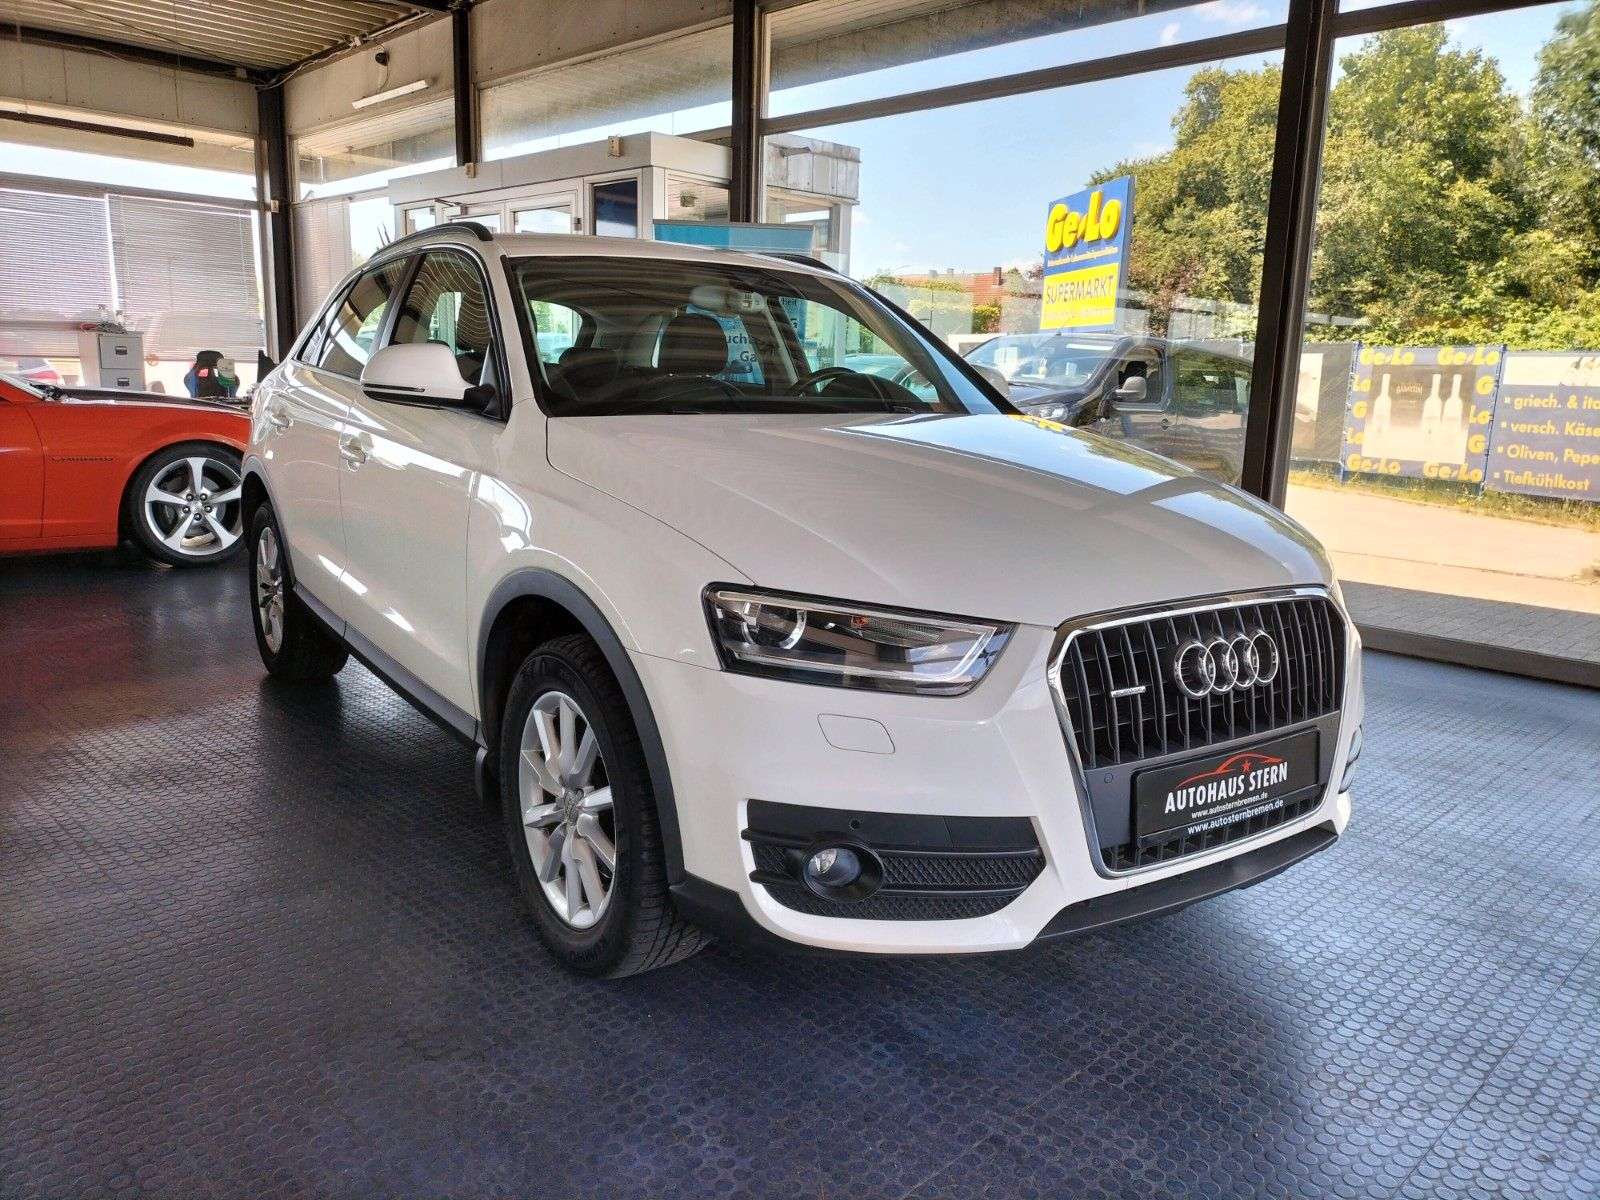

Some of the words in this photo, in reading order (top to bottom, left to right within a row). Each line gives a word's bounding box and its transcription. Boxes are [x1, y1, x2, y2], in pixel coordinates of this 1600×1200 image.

[1046, 275, 1114, 304] SUPERMARKT
[1566, 395, 1579, 408] &
[1511, 420, 1559, 435] versch.
[1507, 444, 1558, 464] Oliven,
[1503, 470, 1591, 491] Tiefkühlkost
[1164, 774, 1245, 814] AUTOHAUS
[1249, 761, 1288, 791] STERN
[1187, 799, 1284, 834] www.autosternbremen.de
[1191, 791, 1269, 819] www.autosternbremen.de
